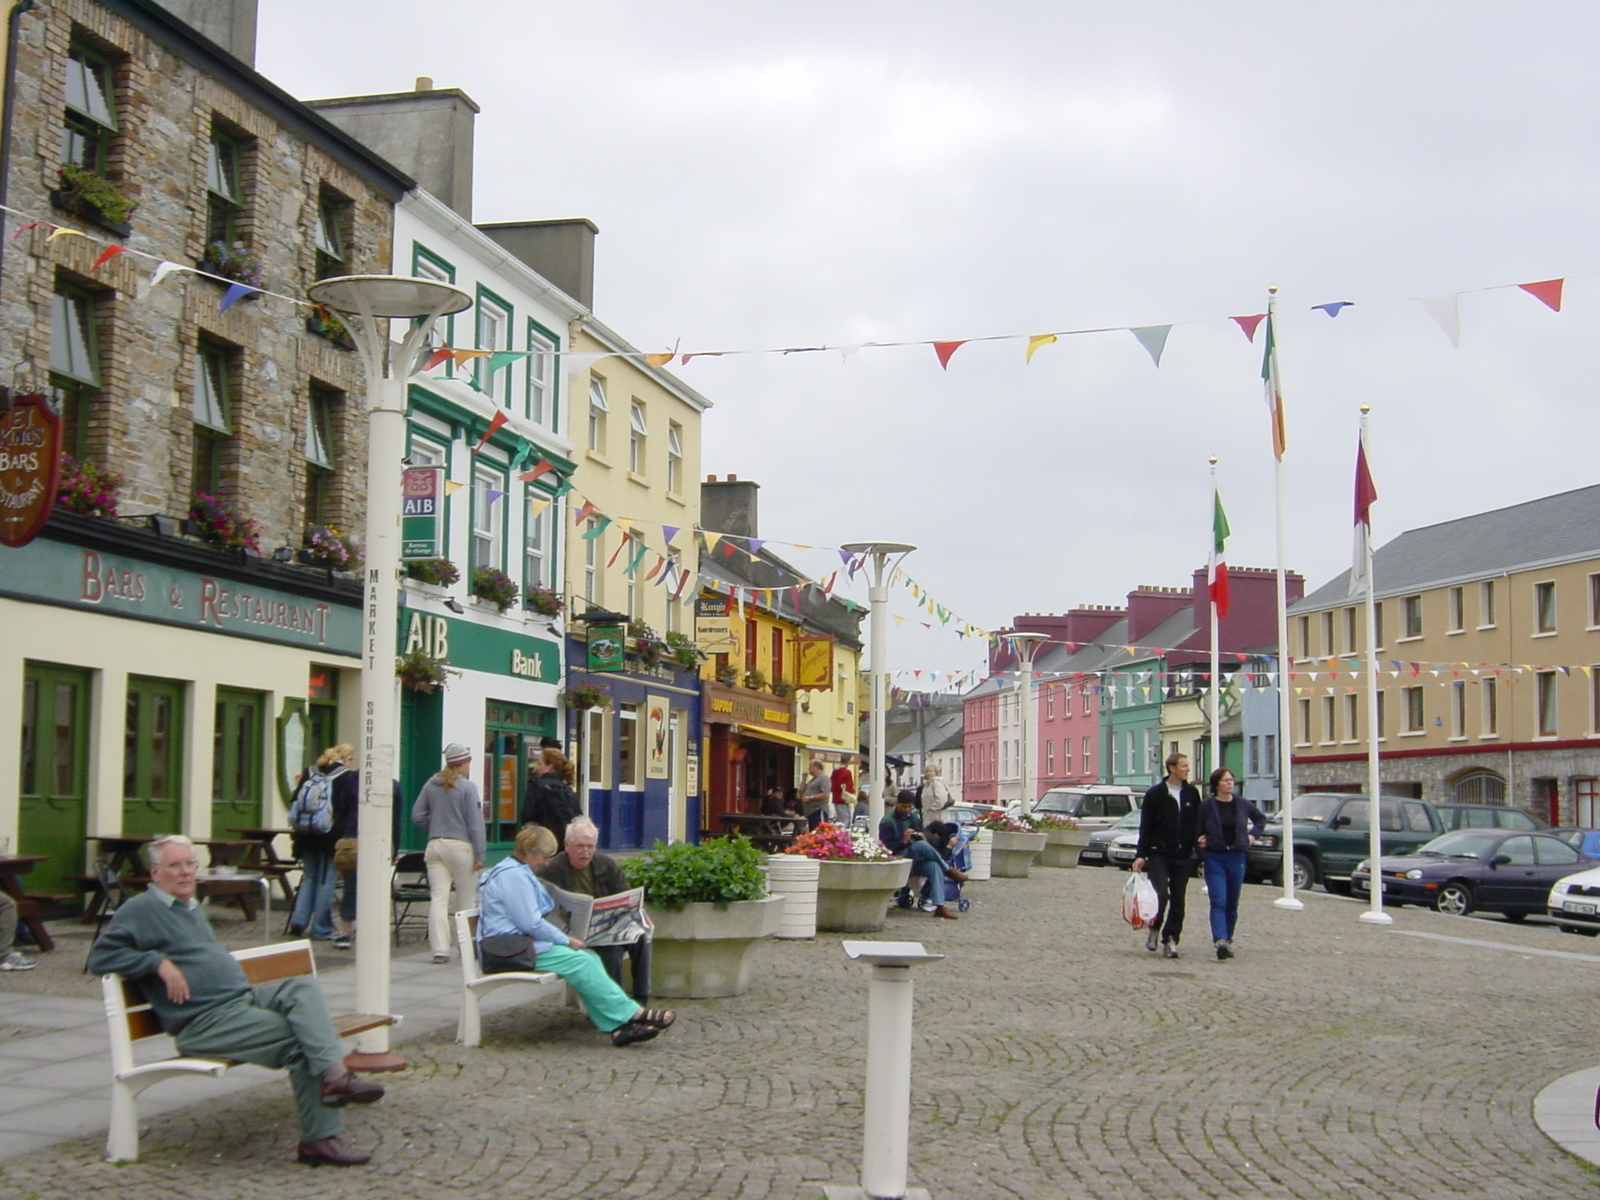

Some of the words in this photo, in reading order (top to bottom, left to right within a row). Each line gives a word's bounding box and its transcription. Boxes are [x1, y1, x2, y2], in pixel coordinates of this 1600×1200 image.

[0, 452, 39, 473] BARS
[404, 498, 434, 514] AIB
[168, 582, 186, 610] &
[368, 569, 380, 671] MARKET
[404, 612, 448, 661] AIB
[511, 648, 542, 678] Bank
[364, 701, 374, 804] SQUARE
